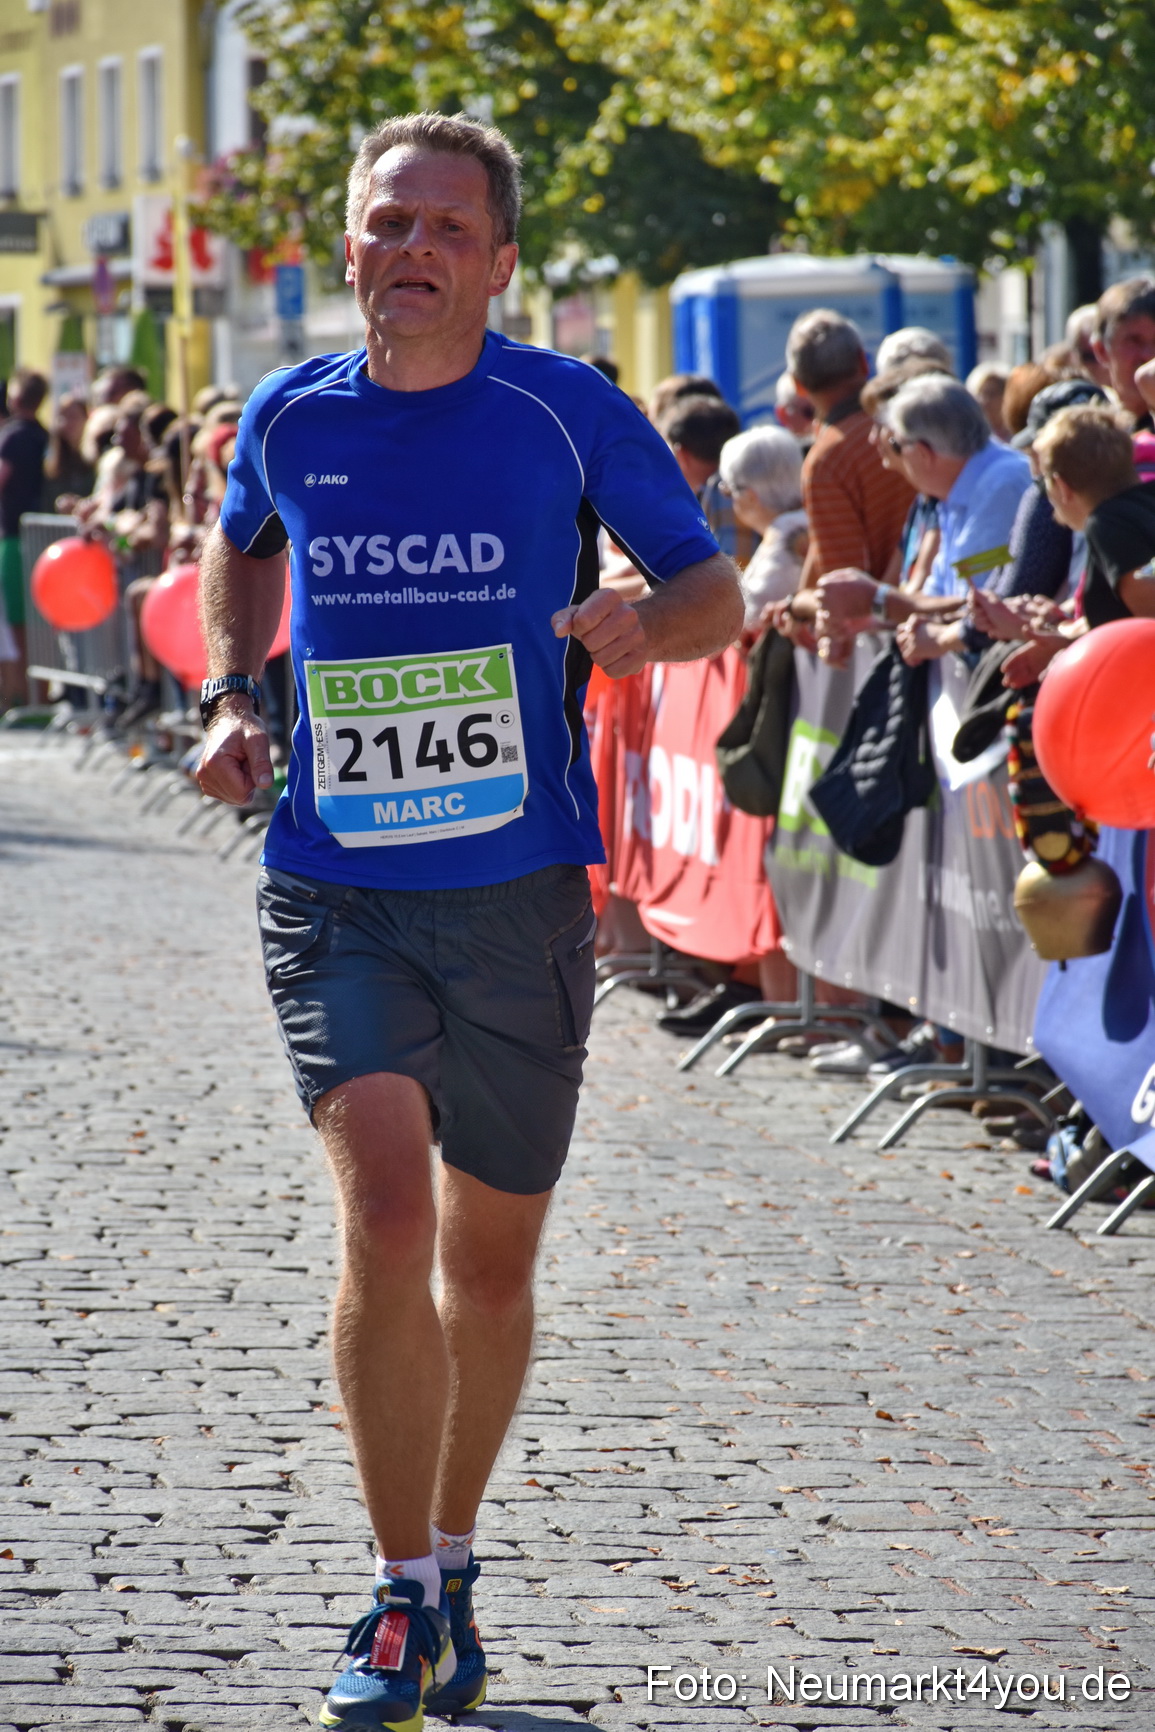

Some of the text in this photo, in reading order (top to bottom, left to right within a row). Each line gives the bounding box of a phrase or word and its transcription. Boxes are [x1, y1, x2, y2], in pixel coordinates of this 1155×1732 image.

[317, 474, 348, 485] JAKO
[309, 533, 505, 577] SYSCAD
[311, 583, 517, 606] www.metallbau-cad.de
[321, 656, 497, 709] BOCK
[500, 714, 510, 724] C
[335, 713, 499, 783] 2146
[372, 792, 466, 825] MARC
